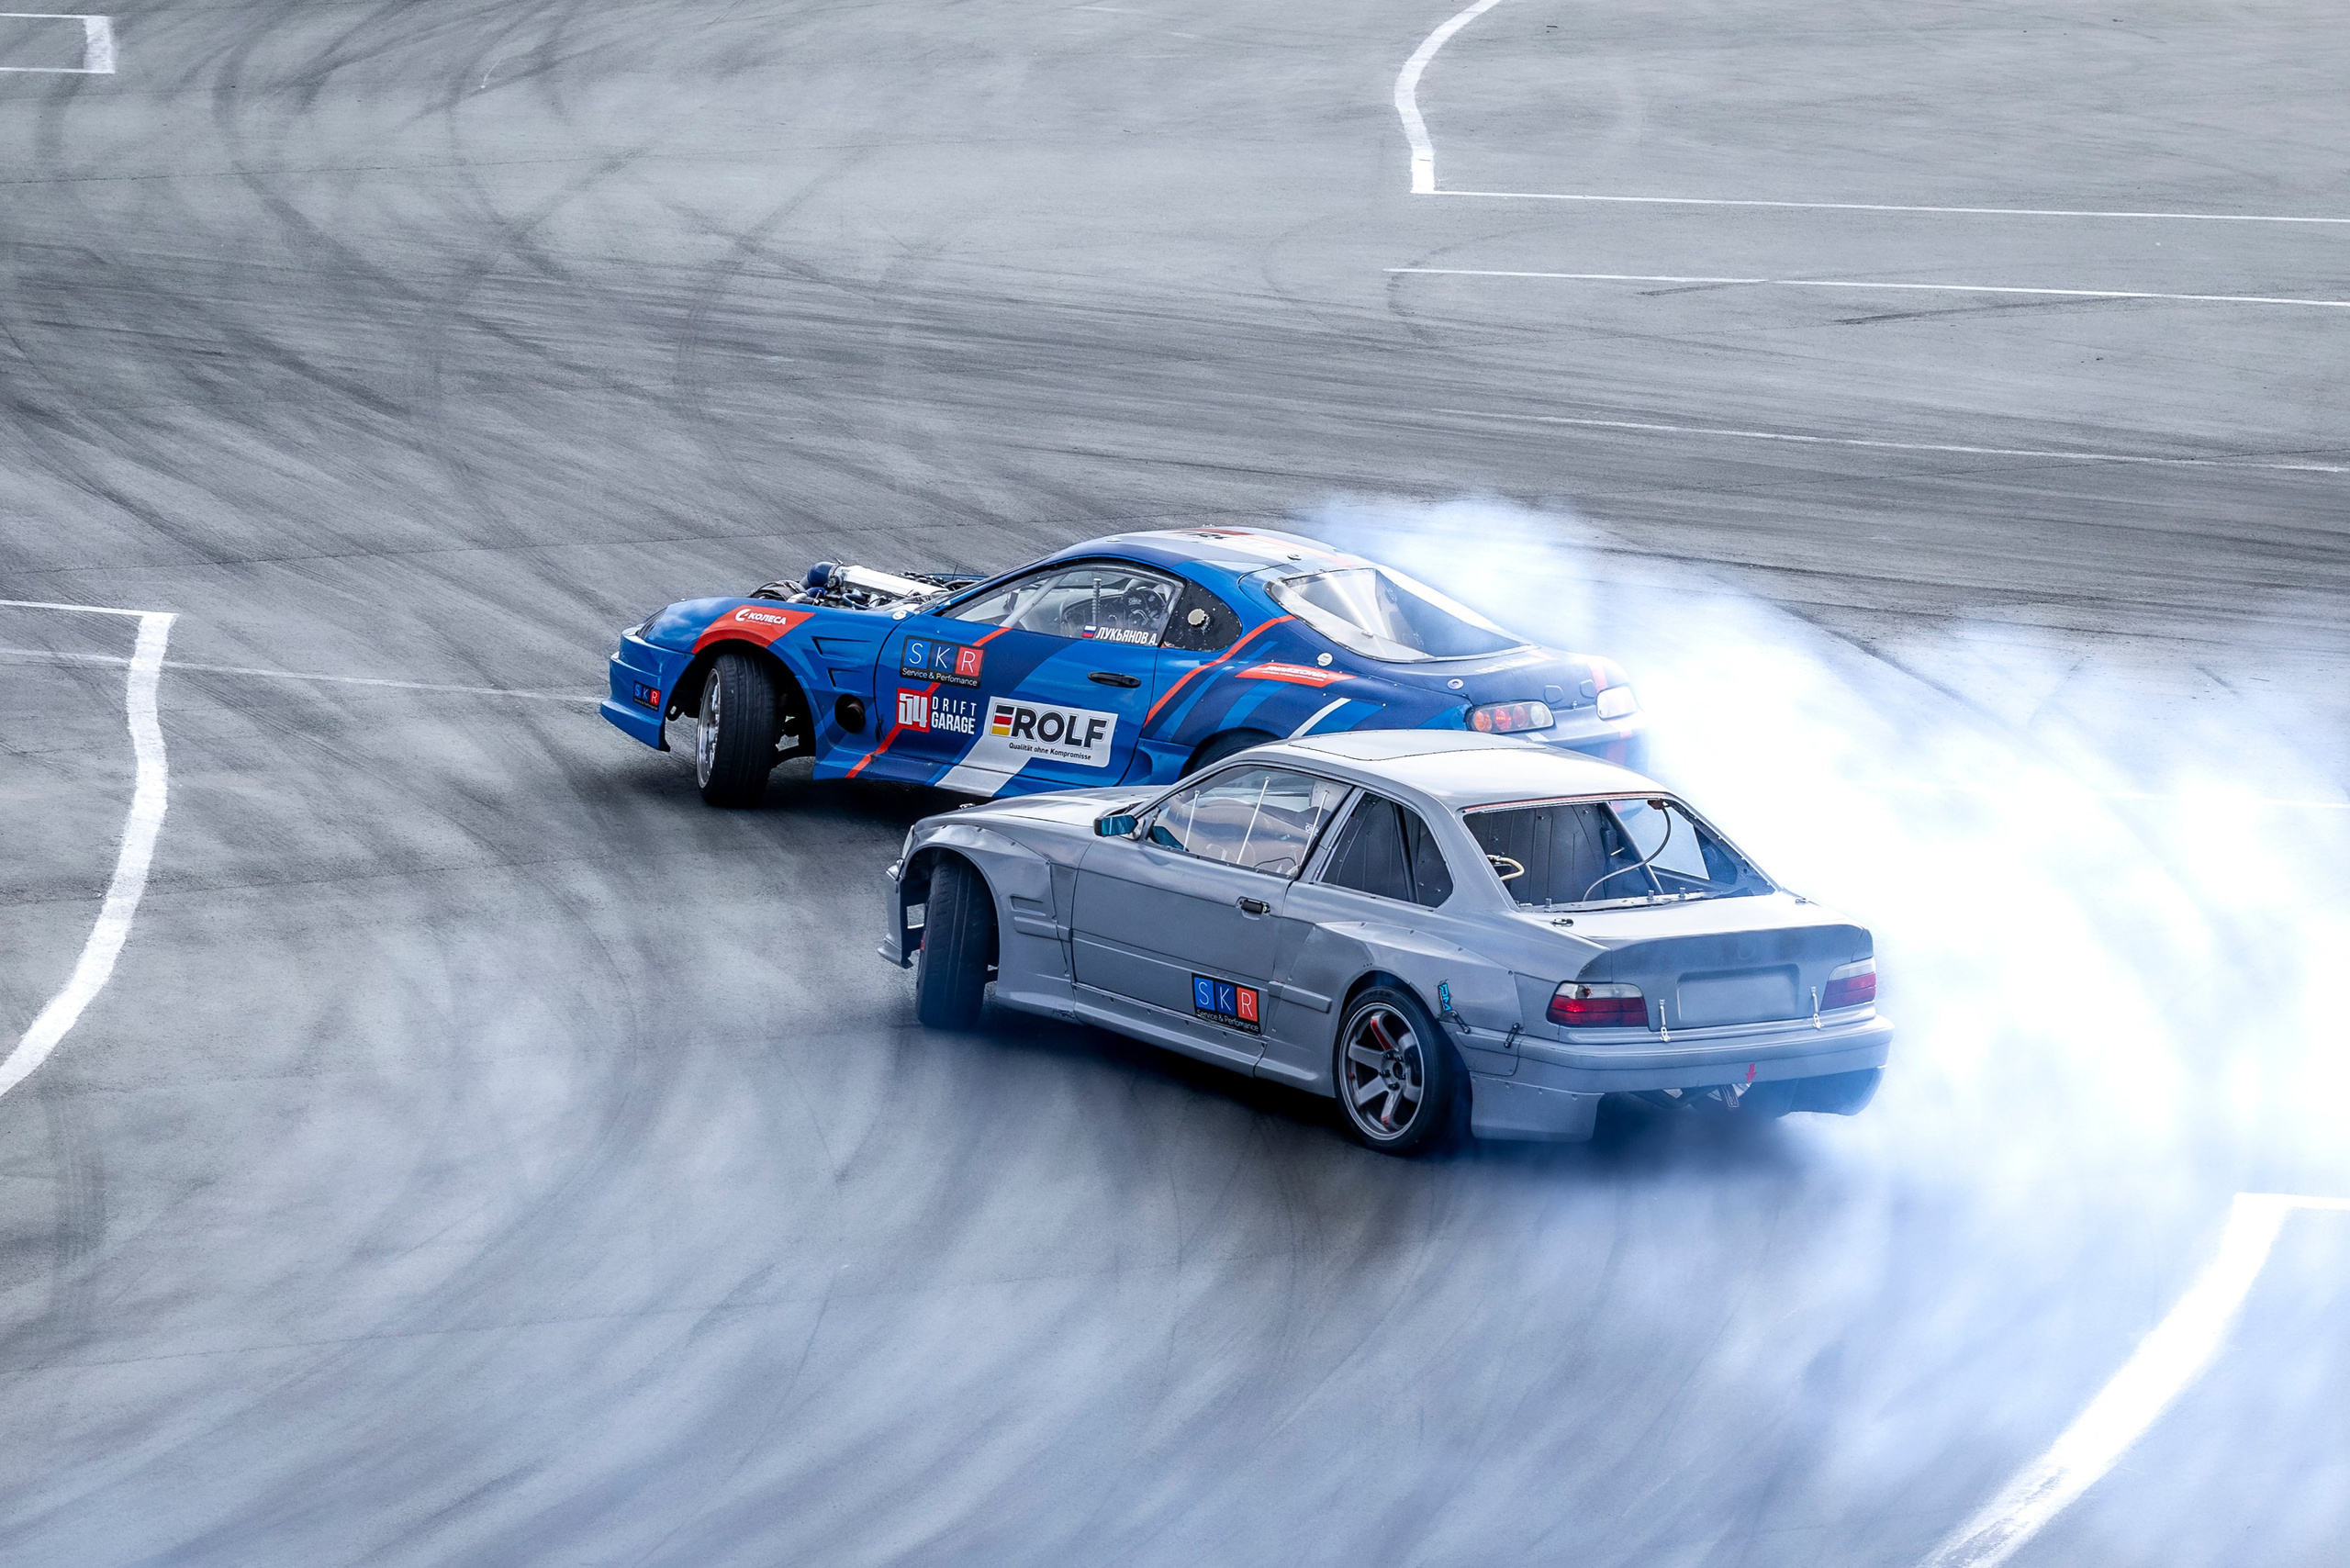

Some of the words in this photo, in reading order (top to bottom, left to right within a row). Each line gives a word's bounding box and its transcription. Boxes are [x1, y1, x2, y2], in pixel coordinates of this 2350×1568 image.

[748, 612, 787, 625] КОЛЕСА
[1096, 626, 1149, 644] ЛУКЬЯНОВ
[909, 643, 976, 673] SKR
[902, 667, 928, 678] Service
[928, 672, 935, 680] &
[936, 672, 978, 687] Perfomance
[634, 684, 658, 704] SKR
[932, 696, 977, 716] DRIFT
[931, 711, 976, 734] GARAGE
[1011, 707, 1107, 748] ROLF
[1009, 742, 1033, 753] Qualität
[1034, 746, 1048, 755] ohne
[1049, 748, 1091, 760] Kompromisse
[1198, 981, 1253, 1017] SKR
[1196, 1009, 1218, 1021] Service
[1218, 1013, 1224, 1023] &
